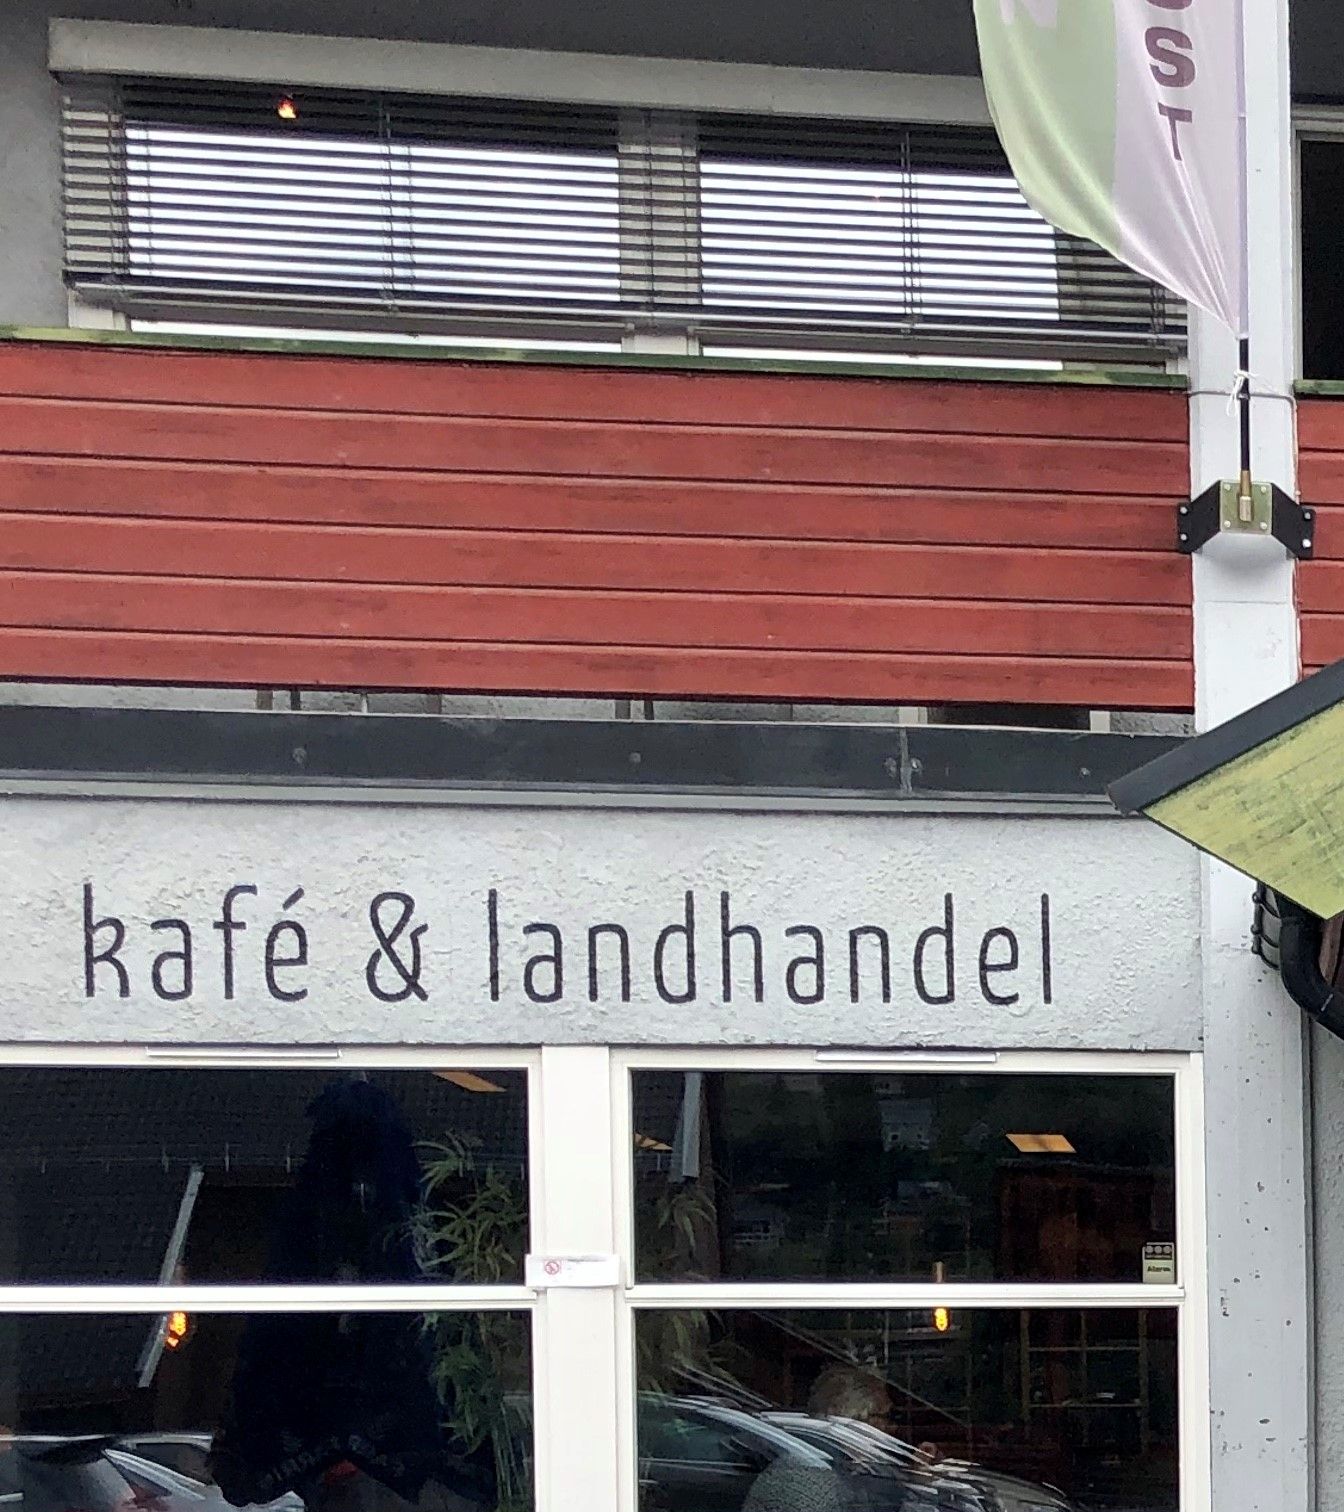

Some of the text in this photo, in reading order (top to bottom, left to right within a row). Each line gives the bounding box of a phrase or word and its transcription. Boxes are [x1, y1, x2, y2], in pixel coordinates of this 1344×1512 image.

[1144, 0, 1196, 161] ST
[83, 882, 1053, 1006] kafé & landhandel
